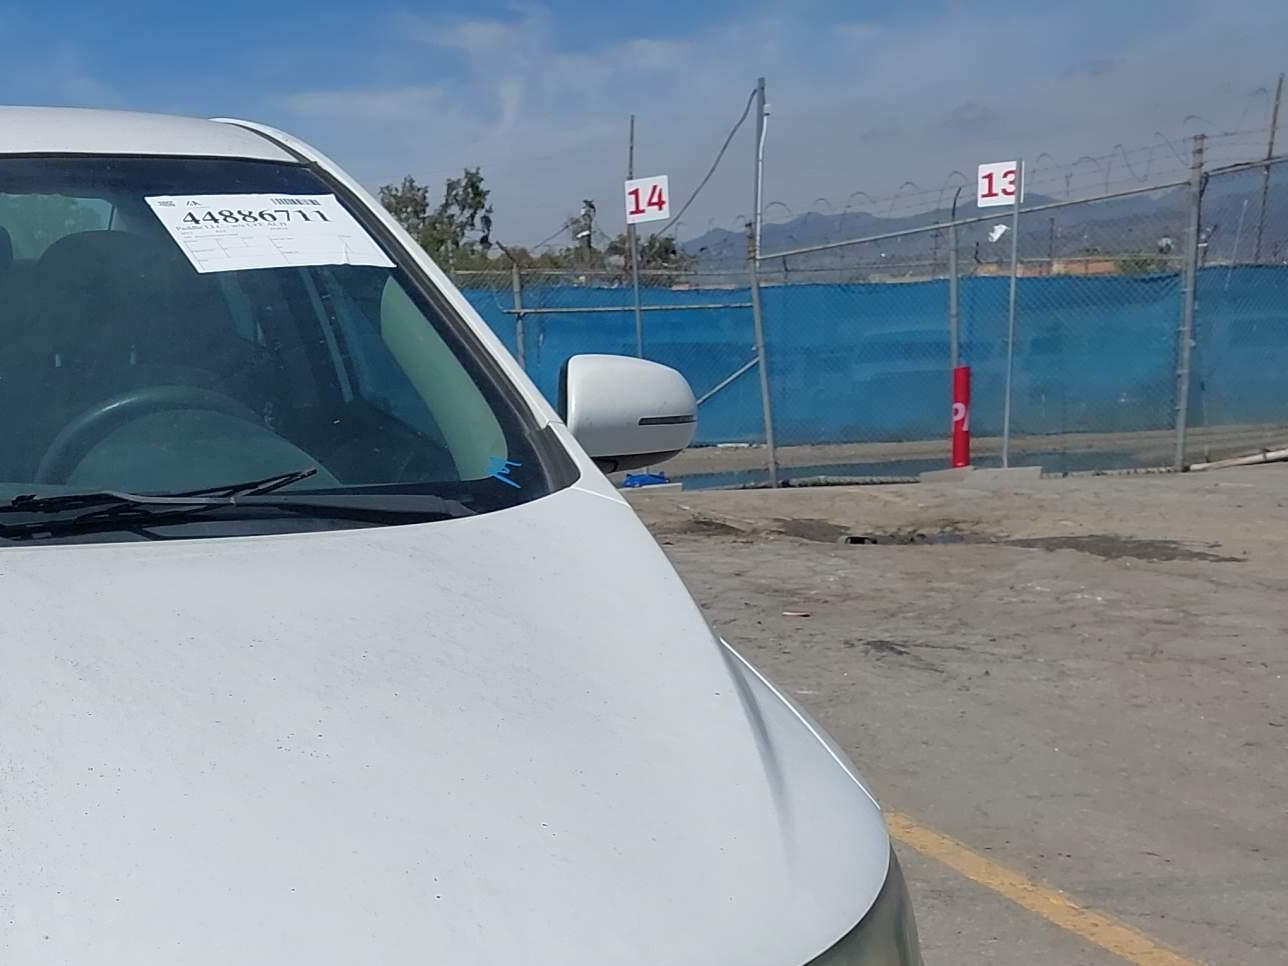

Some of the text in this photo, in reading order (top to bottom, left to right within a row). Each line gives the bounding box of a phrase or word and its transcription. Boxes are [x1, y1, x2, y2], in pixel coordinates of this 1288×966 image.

[981, 170, 1016, 198] 13
[628, 184, 666, 215] 14
[182, 209, 330, 225] 44886711
